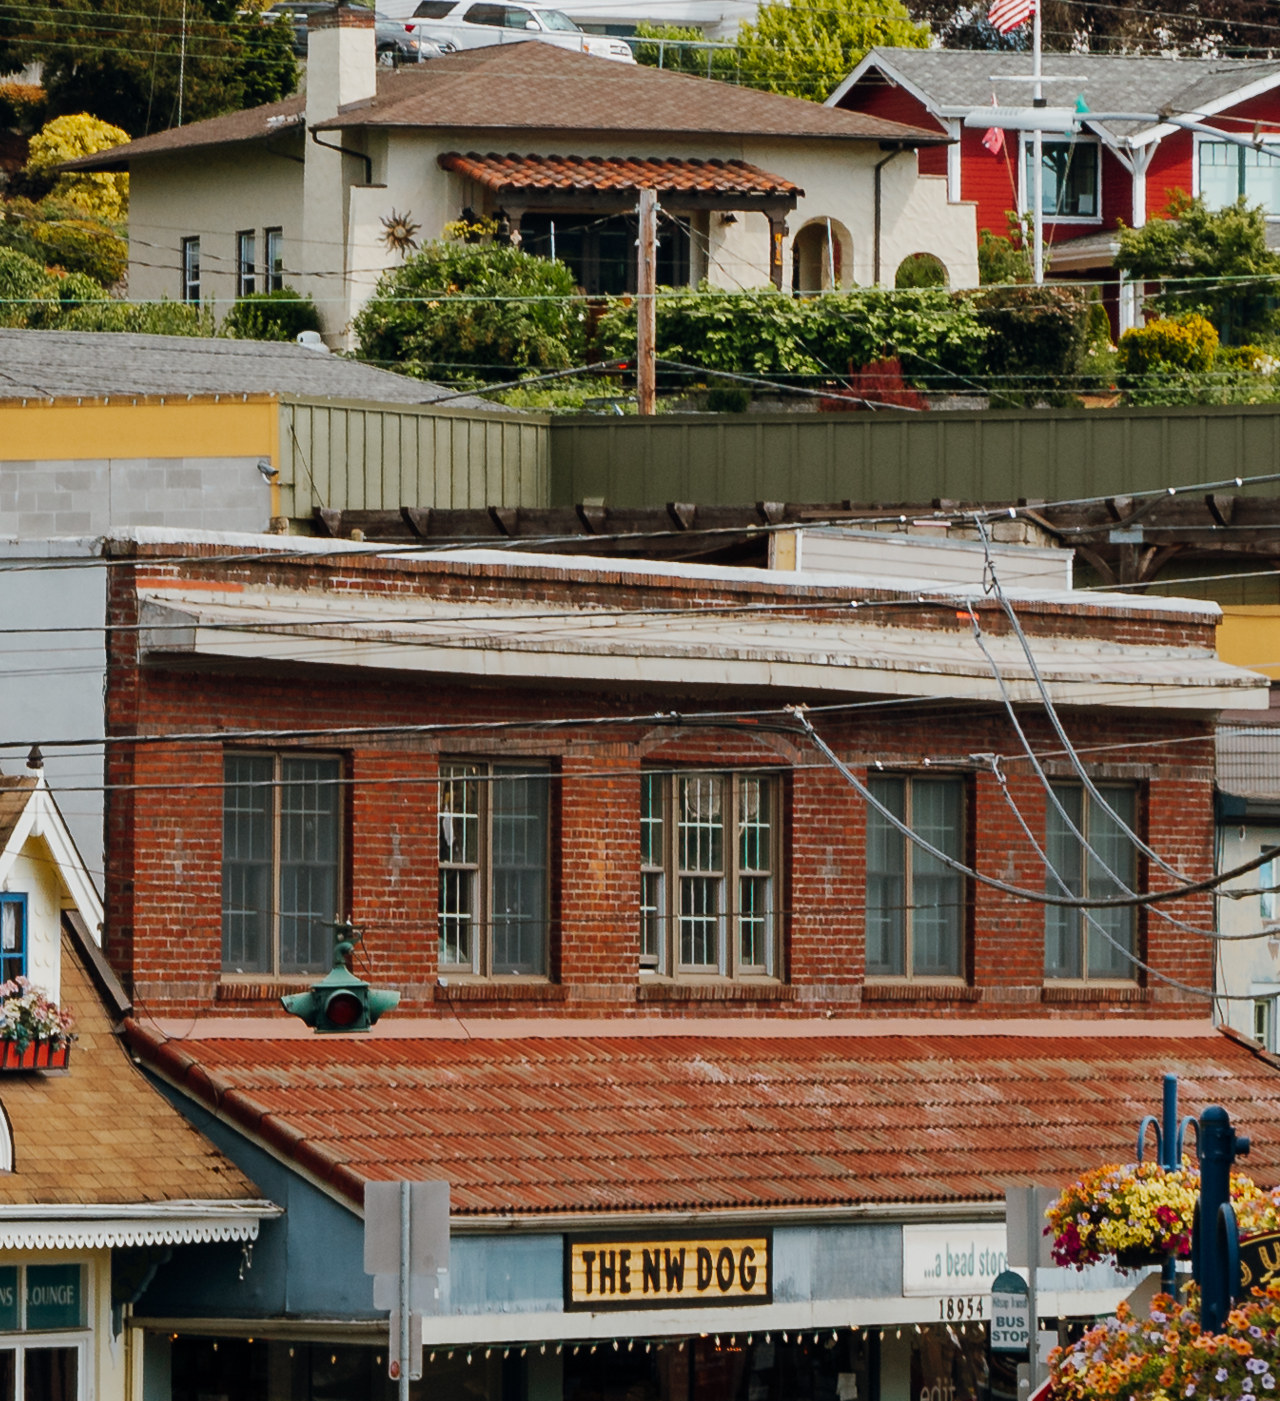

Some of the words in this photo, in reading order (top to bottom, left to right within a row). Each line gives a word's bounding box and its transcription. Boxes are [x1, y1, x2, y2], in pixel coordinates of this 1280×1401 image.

[582, 1249, 632, 1294] THE
[642, 1247, 686, 1293] NW
[696, 1245, 757, 1292] DOG
[946, 1241, 975, 1277] bead
[26, 1285, 75, 1305] OUNGE
[939, 1297, 984, 1320] 18954
[996, 1316, 1025, 1327] BUS
[992, 1331, 1029, 1342] STOP
